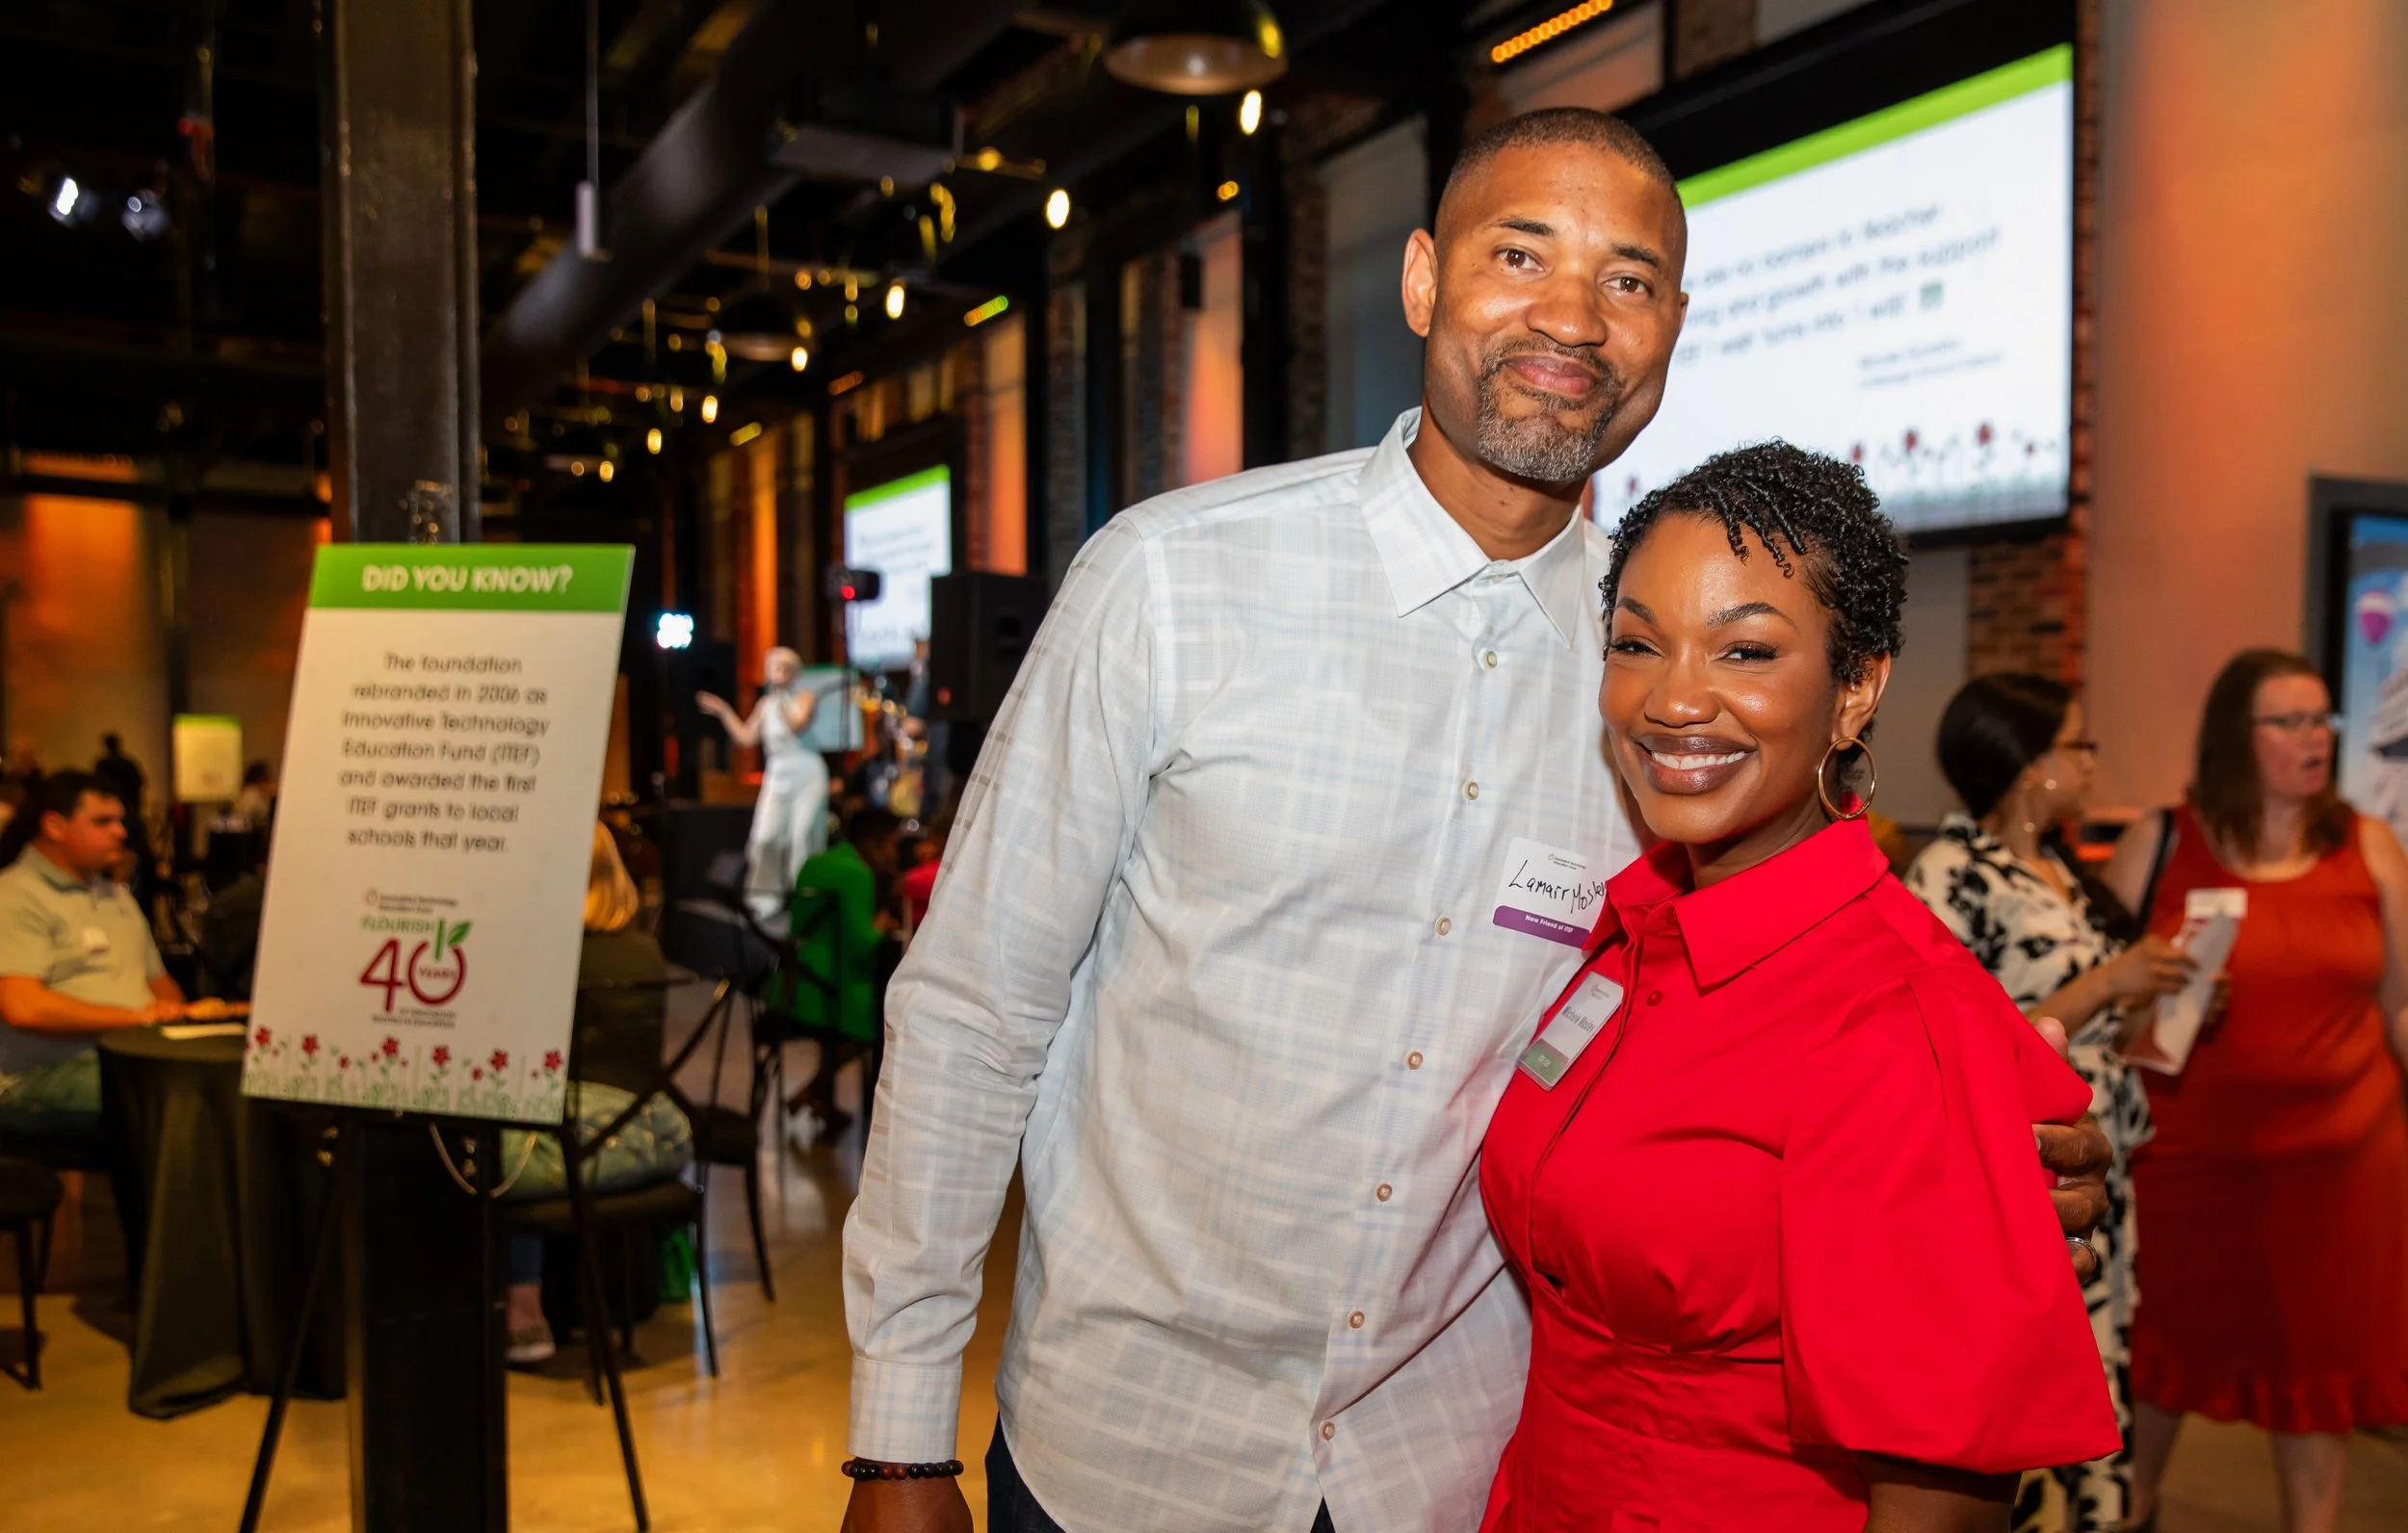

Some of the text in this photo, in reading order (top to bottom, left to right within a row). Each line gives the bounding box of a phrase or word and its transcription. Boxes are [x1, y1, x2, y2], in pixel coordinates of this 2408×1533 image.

[361, 563, 575, 594] DID YOU KNOW?
[385, 651, 523, 673] The foundation
[353, 683, 549, 705] rebranded in 2006 as
[342, 711, 550, 739] Innovative Technology
[342, 739, 541, 768] Education Fund (ITEF)
[339, 770, 537, 793] and awarded the first
[347, 795, 520, 822] ITEF grants to local
[347, 828, 509, 853] schools that year.
[359, 915, 435, 934] FLOURISH
[1525, 914, 1539, 923] New
[1539, 918, 1558, 929] Friend
[360, 937, 469, 1014] 40
